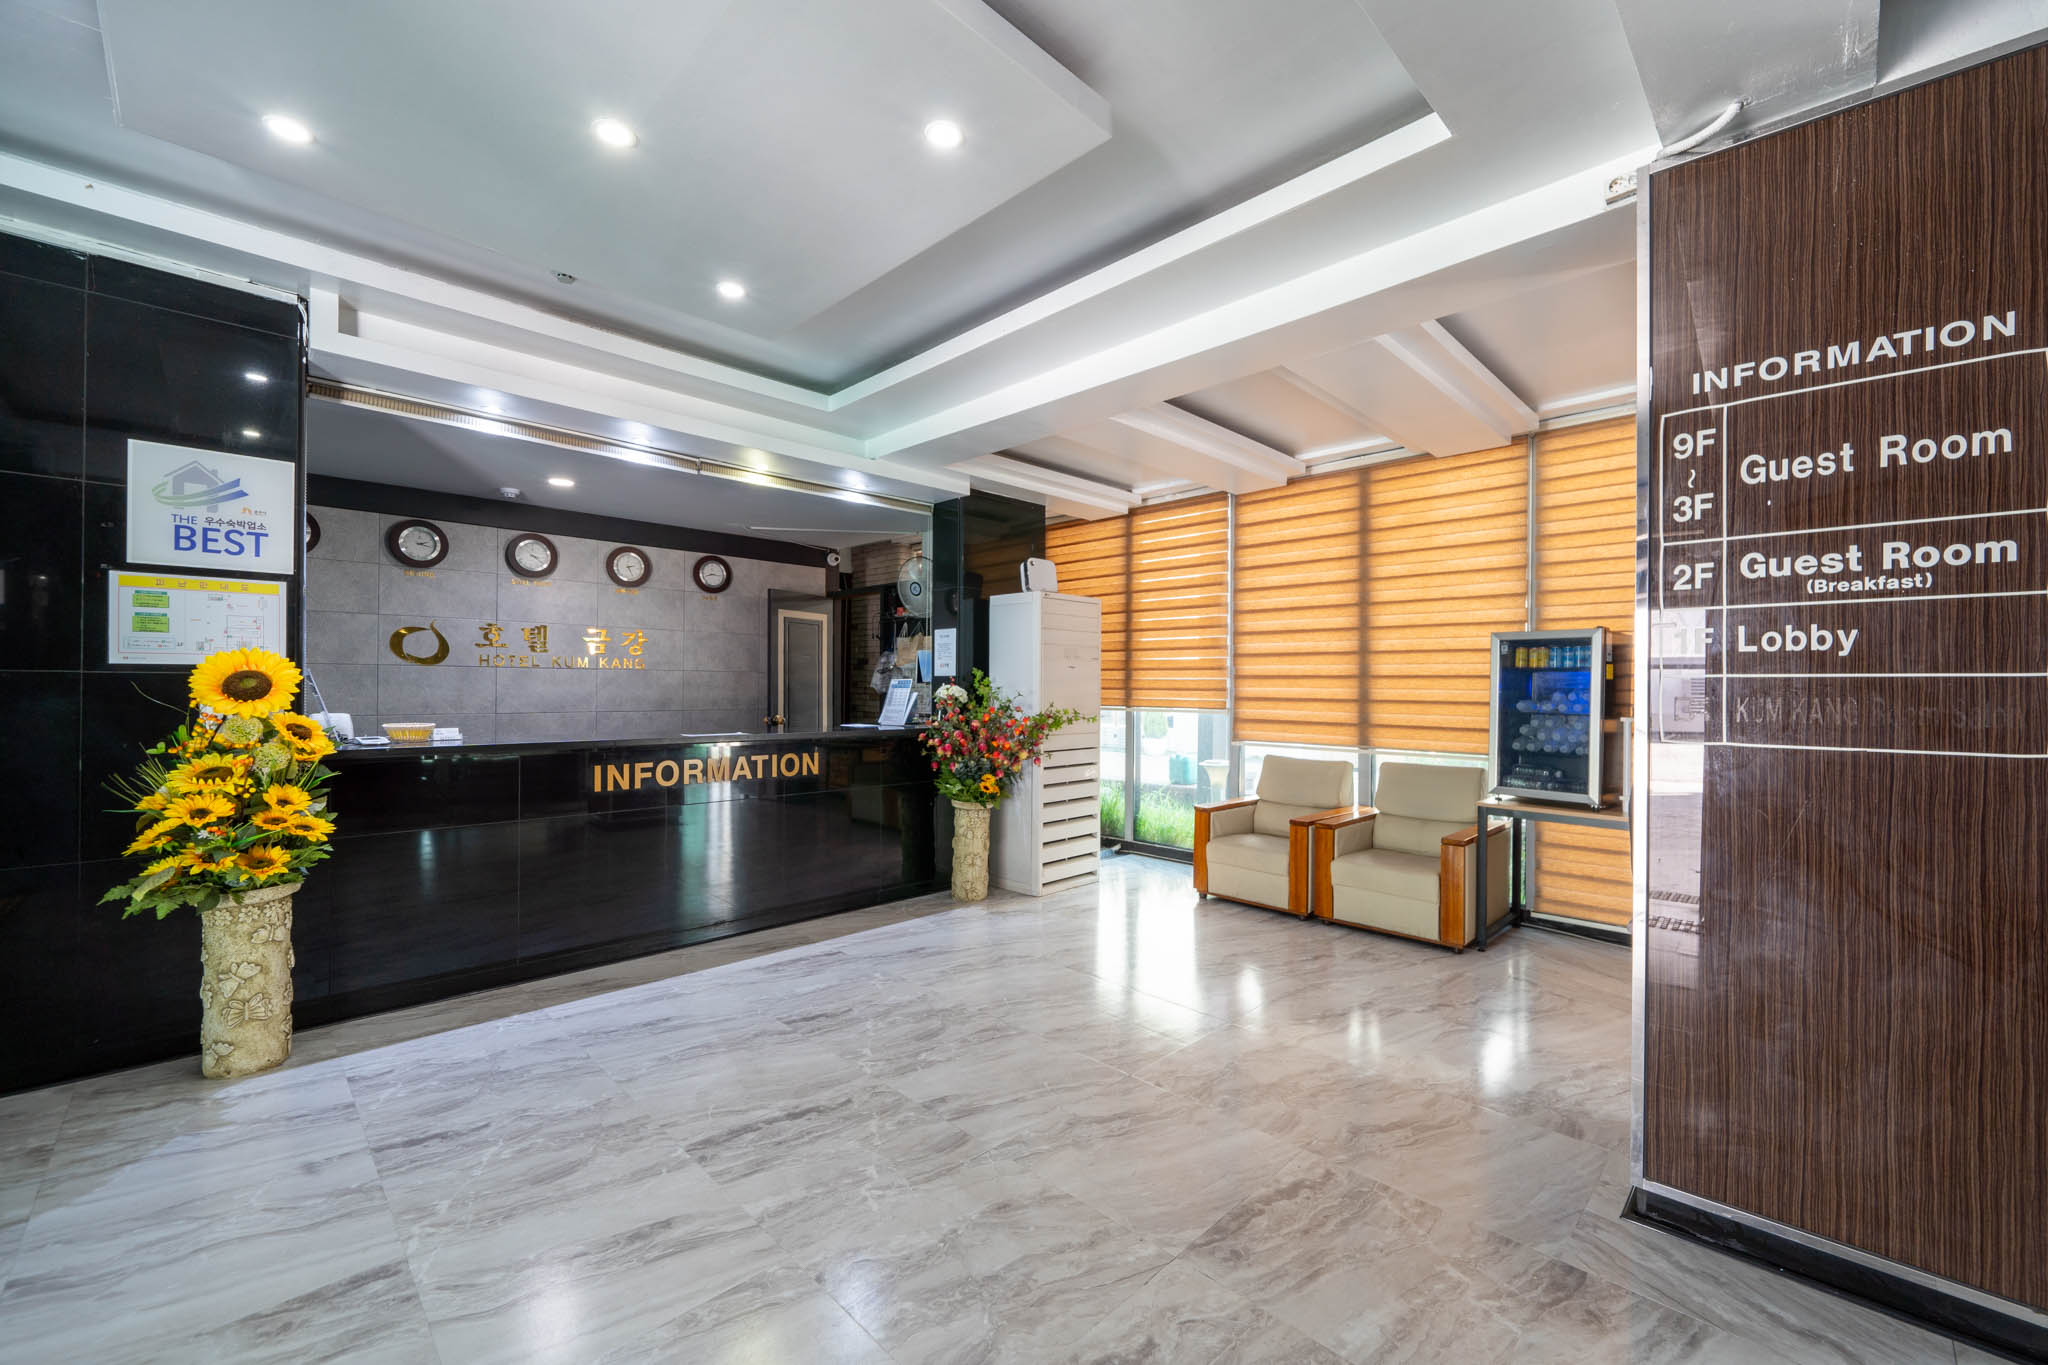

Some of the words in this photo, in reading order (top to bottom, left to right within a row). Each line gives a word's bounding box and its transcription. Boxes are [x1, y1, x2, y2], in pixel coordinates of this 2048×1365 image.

[1692, 310, 2017, 395] INFORMATION
[1672, 427, 1717, 460] 9F
[1740, 442, 1854, 485] Guest
[1879, 427, 2013, 468] Room
[170, 513, 198, 525] THE
[204, 516, 267, 531] 우수숙박업소
[1672, 492, 1715, 523] 3F
[173, 523, 270, 558] BEST
[1739, 544, 1862, 580] Guest
[1882, 538, 2018, 570] Room
[1672, 562, 1715, 591] 2F
[1806, 572, 1933, 595] (Breakfast)
[474, 622, 549, 654] 호텔
[582, 626, 649, 656] 금강
[1674, 626, 1715, 655] 1F
[1738, 623, 1859, 657] Lobby
[478, 653, 540, 668] HOTEL
[551, 655, 589, 669] KUM
[599, 657, 646, 670] KANG
[593, 751, 819, 793] INFORMATION
